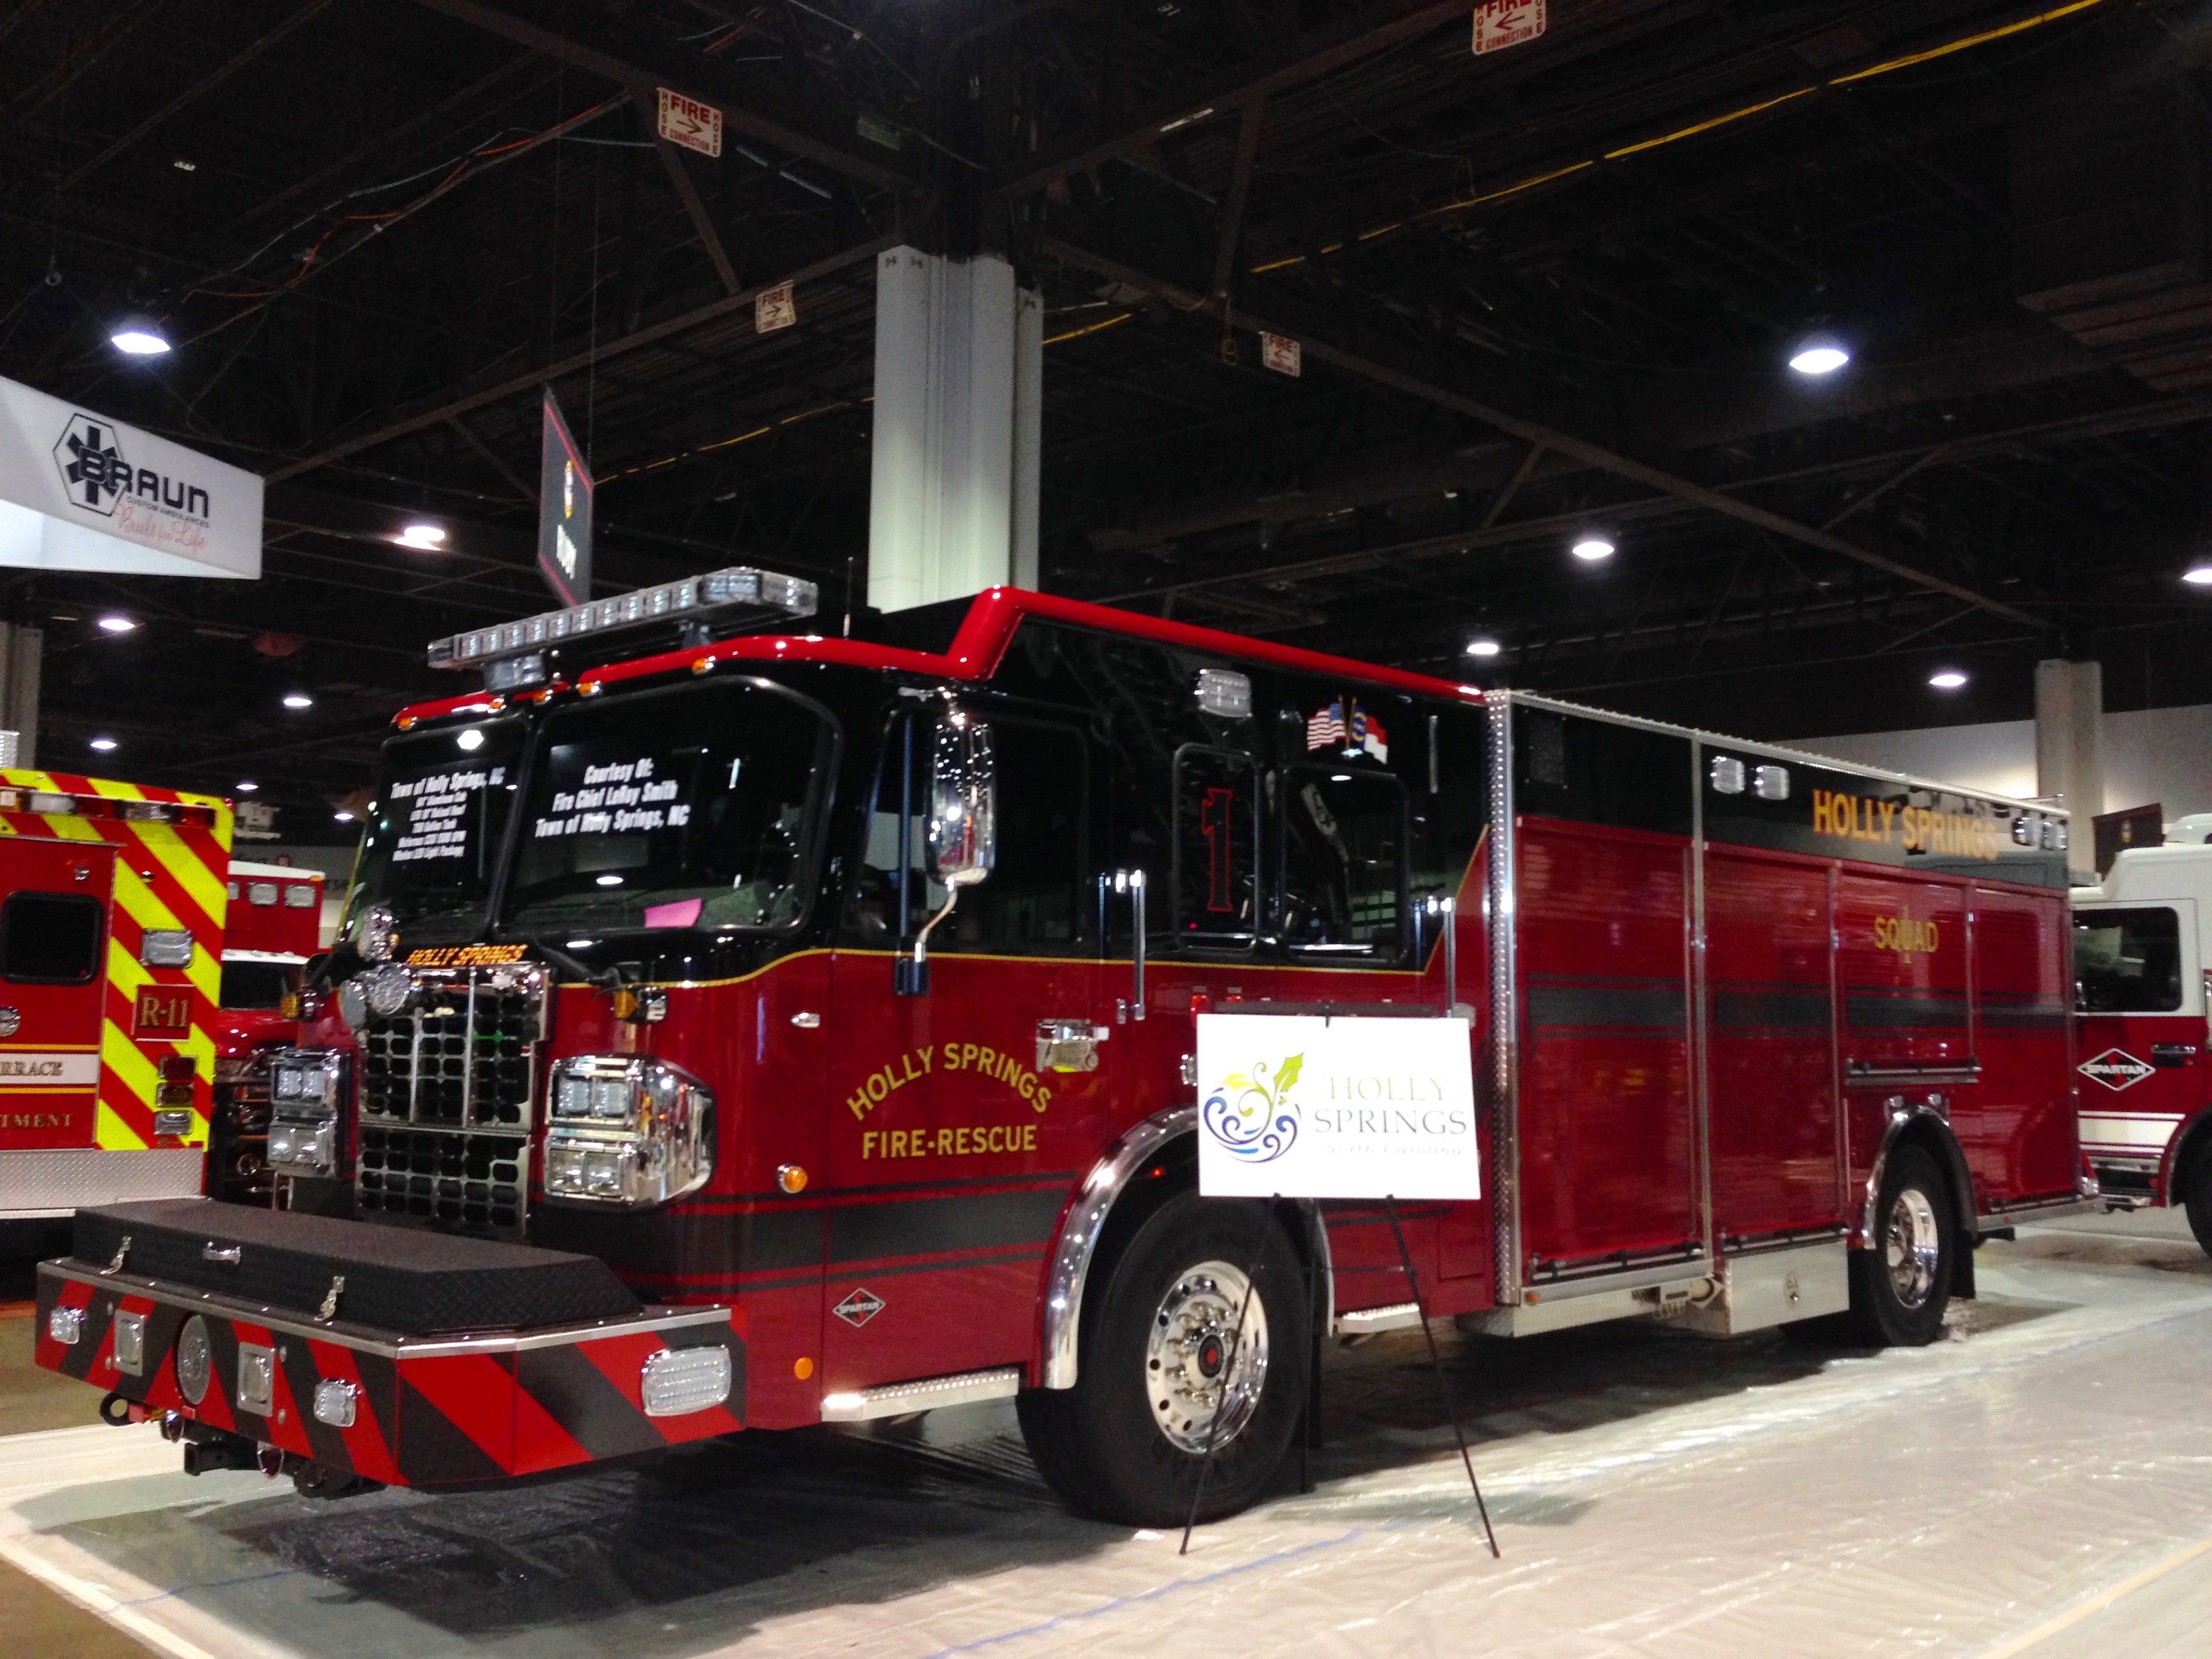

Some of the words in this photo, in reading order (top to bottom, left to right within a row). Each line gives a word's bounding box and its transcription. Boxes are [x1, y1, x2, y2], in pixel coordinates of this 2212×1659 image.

[670, 94, 710, 125] FIRE
[78, 445, 209, 518] BRAUN
[583, 762, 635, 785] Courtesy
[552, 792, 575, 812] Fire
[575, 787, 607, 810] Chief
[642, 780, 678, 802] Smith
[535, 818, 565, 838] Town
[565, 814, 581, 834] of
[580, 811, 613, 834] Holly
[613, 808, 664, 832] Springs,
[667, 804, 691, 826] NC
[1812, 788, 1895, 844] HOLLY
[1902, 806, 2000, 862] SPRINGS
[1874, 917, 1939, 953] SQUAD
[406, 946, 460, 966] HOLLY
[451, 944, 529, 966] SPRINGS
[138, 997, 189, 1028] R-11
[846, 1045, 934, 1121] HOLLY
[944, 1042, 1052, 1113] SPRINGS
[1330, 1076, 1448, 1102] HOLLY
[0, 1113, 73, 1128] TMENT
[1314, 1109, 1467, 1136] SPRINGS
